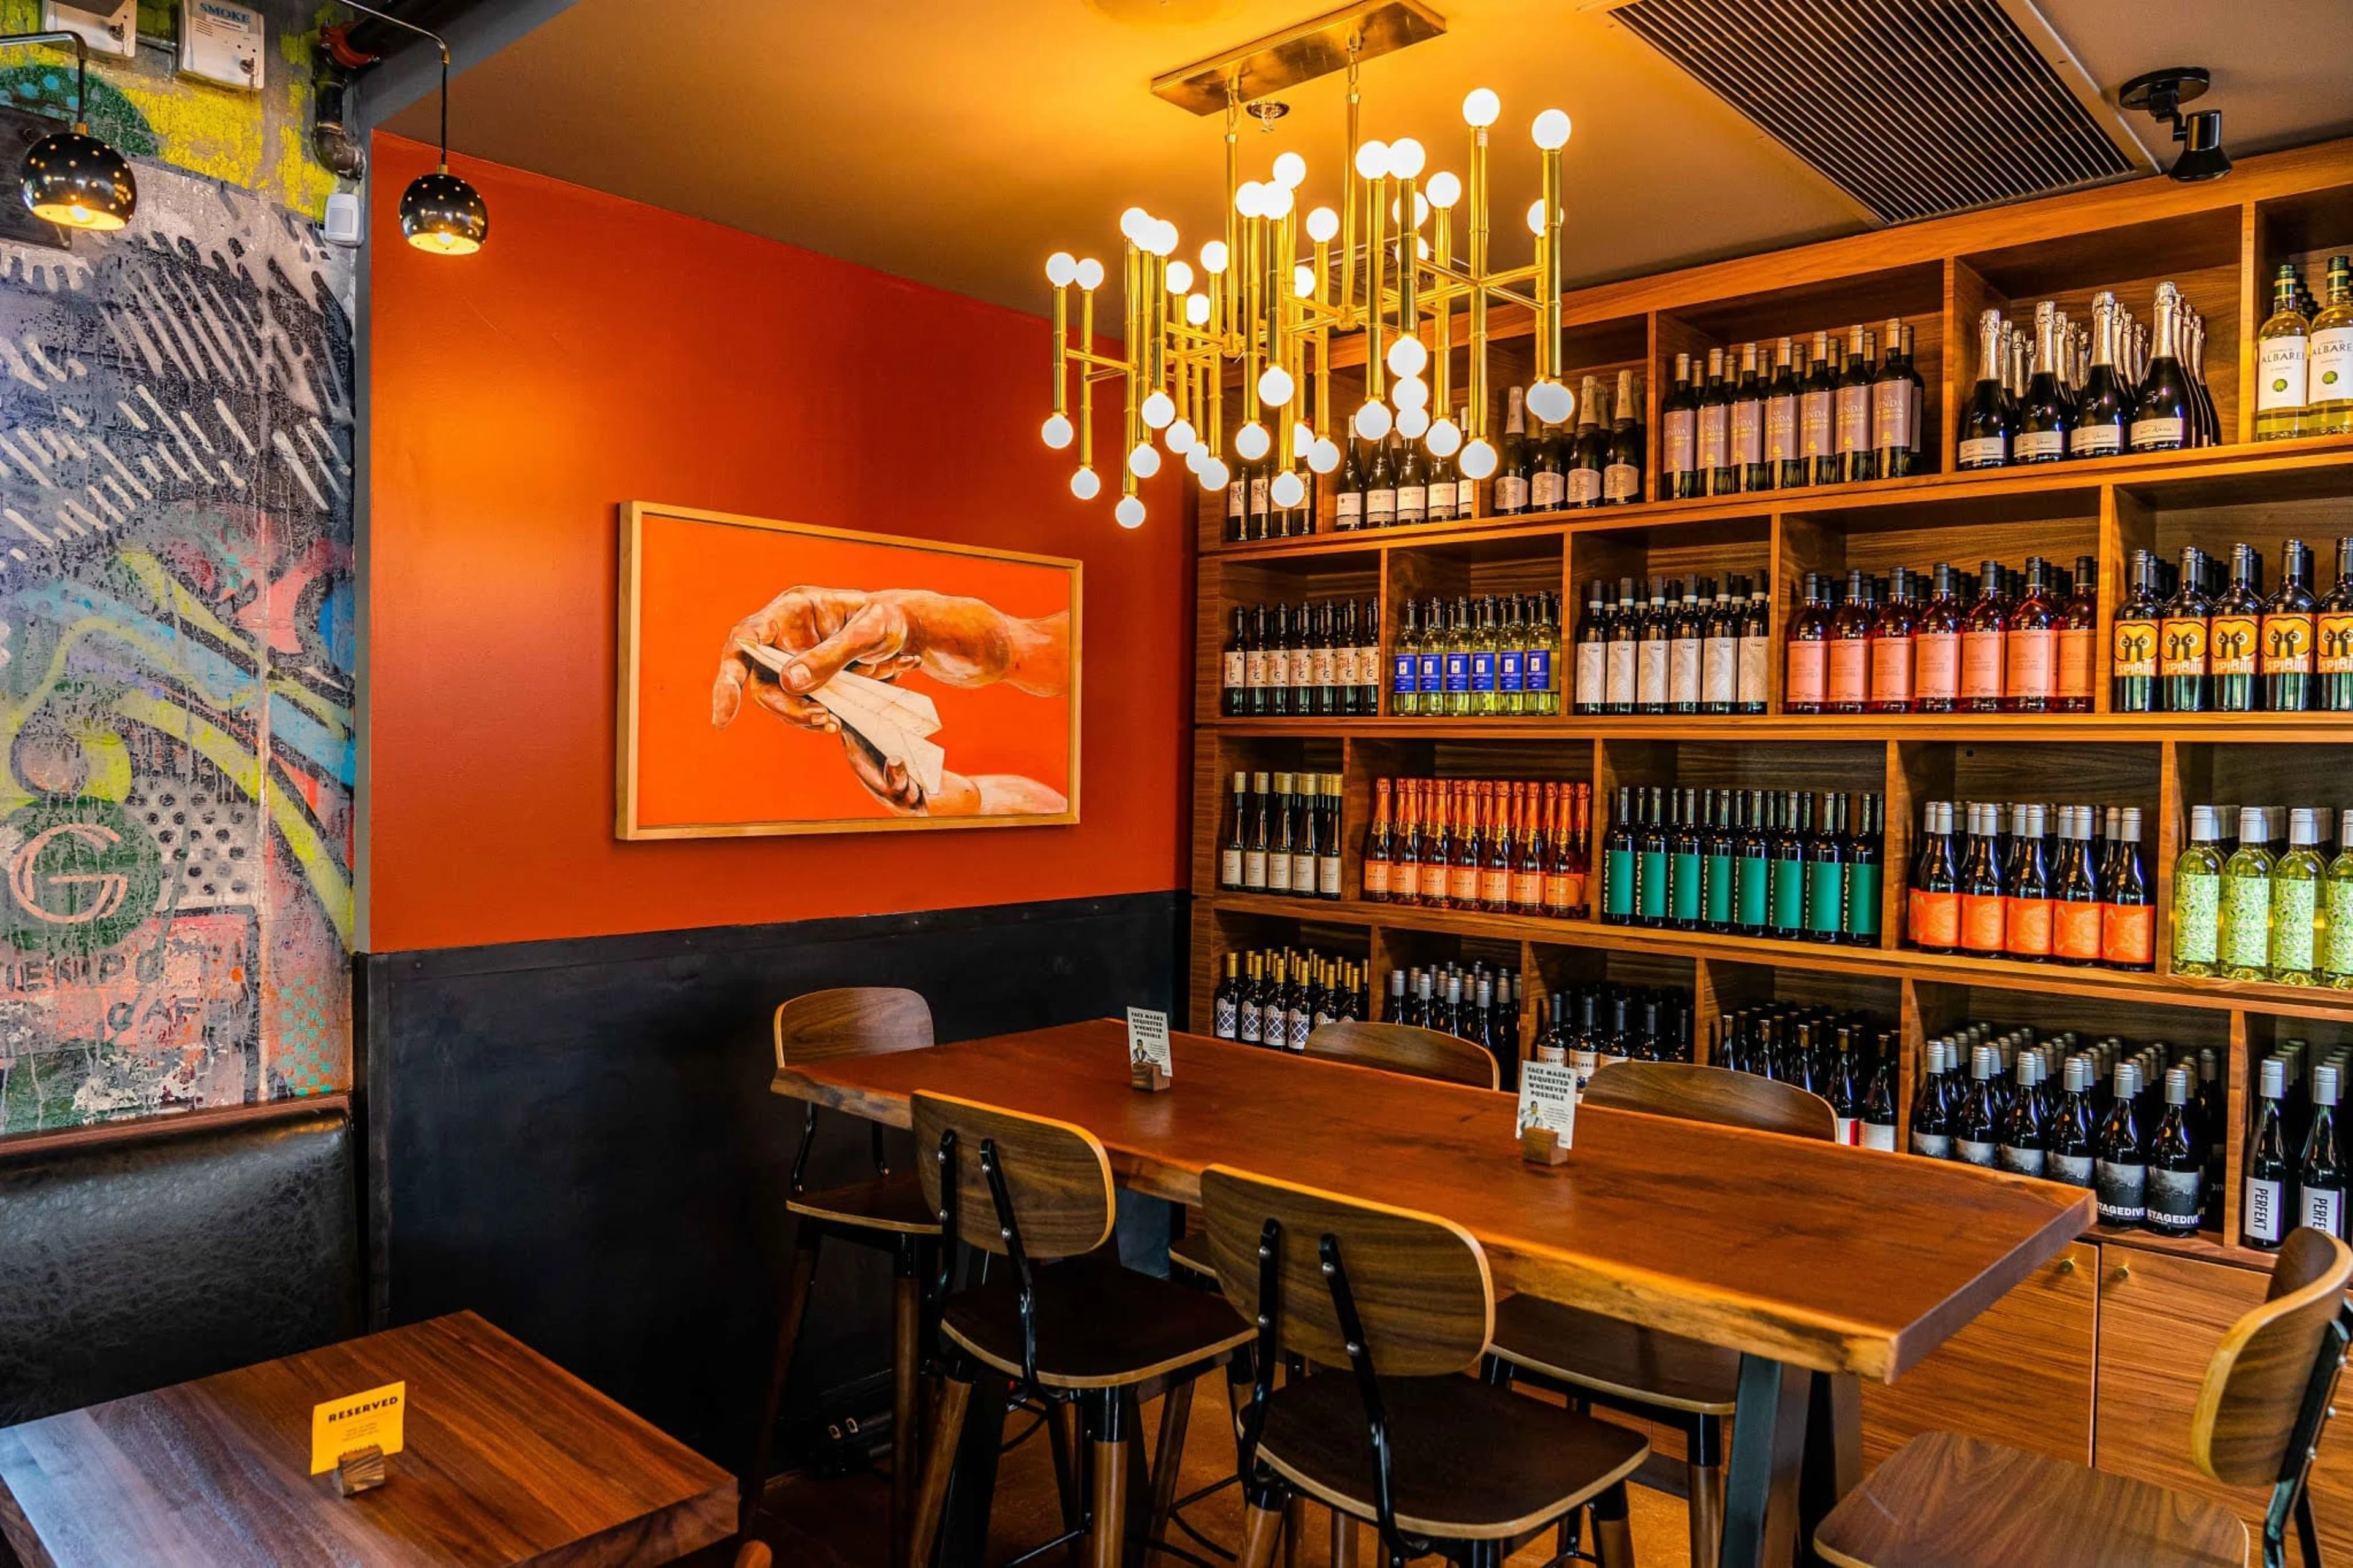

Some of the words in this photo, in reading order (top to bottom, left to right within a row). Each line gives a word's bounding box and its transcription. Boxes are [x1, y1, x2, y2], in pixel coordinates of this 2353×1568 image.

[200, 2, 251, 24] SMOKE
[1529, 1074, 1569, 1086] REQUESTED
[1546, 1070, 1571, 1079] MASKS
[1528, 1083, 1567, 1094] WHENEVER
[1531, 1090, 1564, 1101] POSSIBLE
[2254, 1187, 2269, 1230] PERFEKT
[2313, 1197, 2327, 1231] PERFE
[328, 1396, 398, 1423] RESERVED
